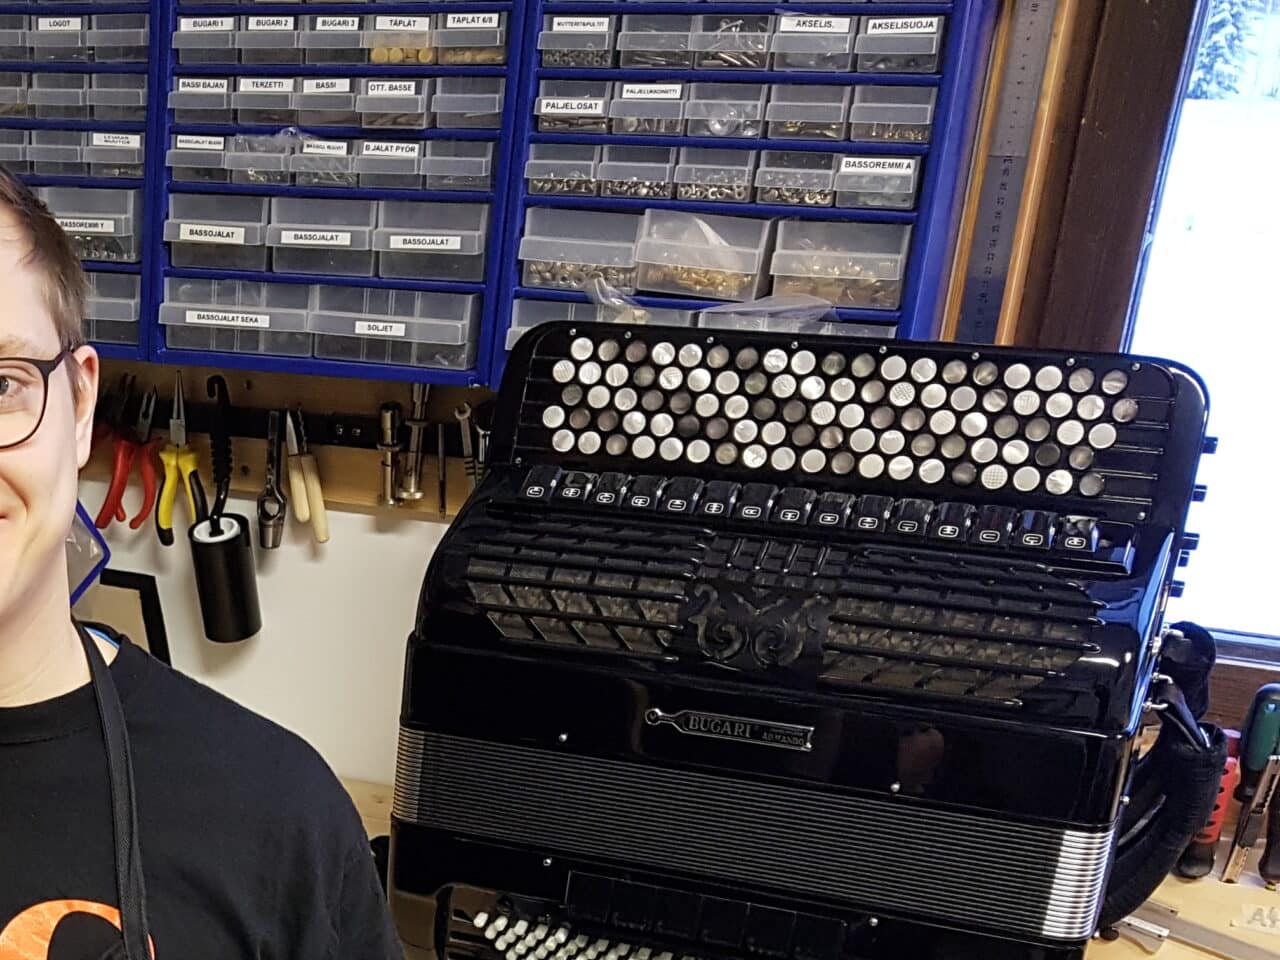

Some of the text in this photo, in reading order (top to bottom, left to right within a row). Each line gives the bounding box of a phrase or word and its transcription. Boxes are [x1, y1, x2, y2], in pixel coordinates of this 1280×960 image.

[193, 19, 219, 27] BUGARI
[256, 18, 283, 26] BUGARI
[321, 19, 351, 27] BUGARI
[871, 21, 934, 30] AKSELISUOJA
[202, 81, 225, 89] BAJAN
[251, 80, 284, 89] TERZETTI
[315, 81, 337, 89] BASSI
[370, 83, 413, 92] OTT. BASSE
[844, 160, 904, 169] BASSOREMMI
[189, 228, 235, 239] BASSOJALAT
[293, 232, 339, 241] BASSOJALAT
[402, 237, 449, 247] BASSOJALAT
[196, 312, 259, 324] BASSOJALAT SEKA
[367, 323, 393, 333] SOLJET
[688, 715, 752, 738] BUGARI
